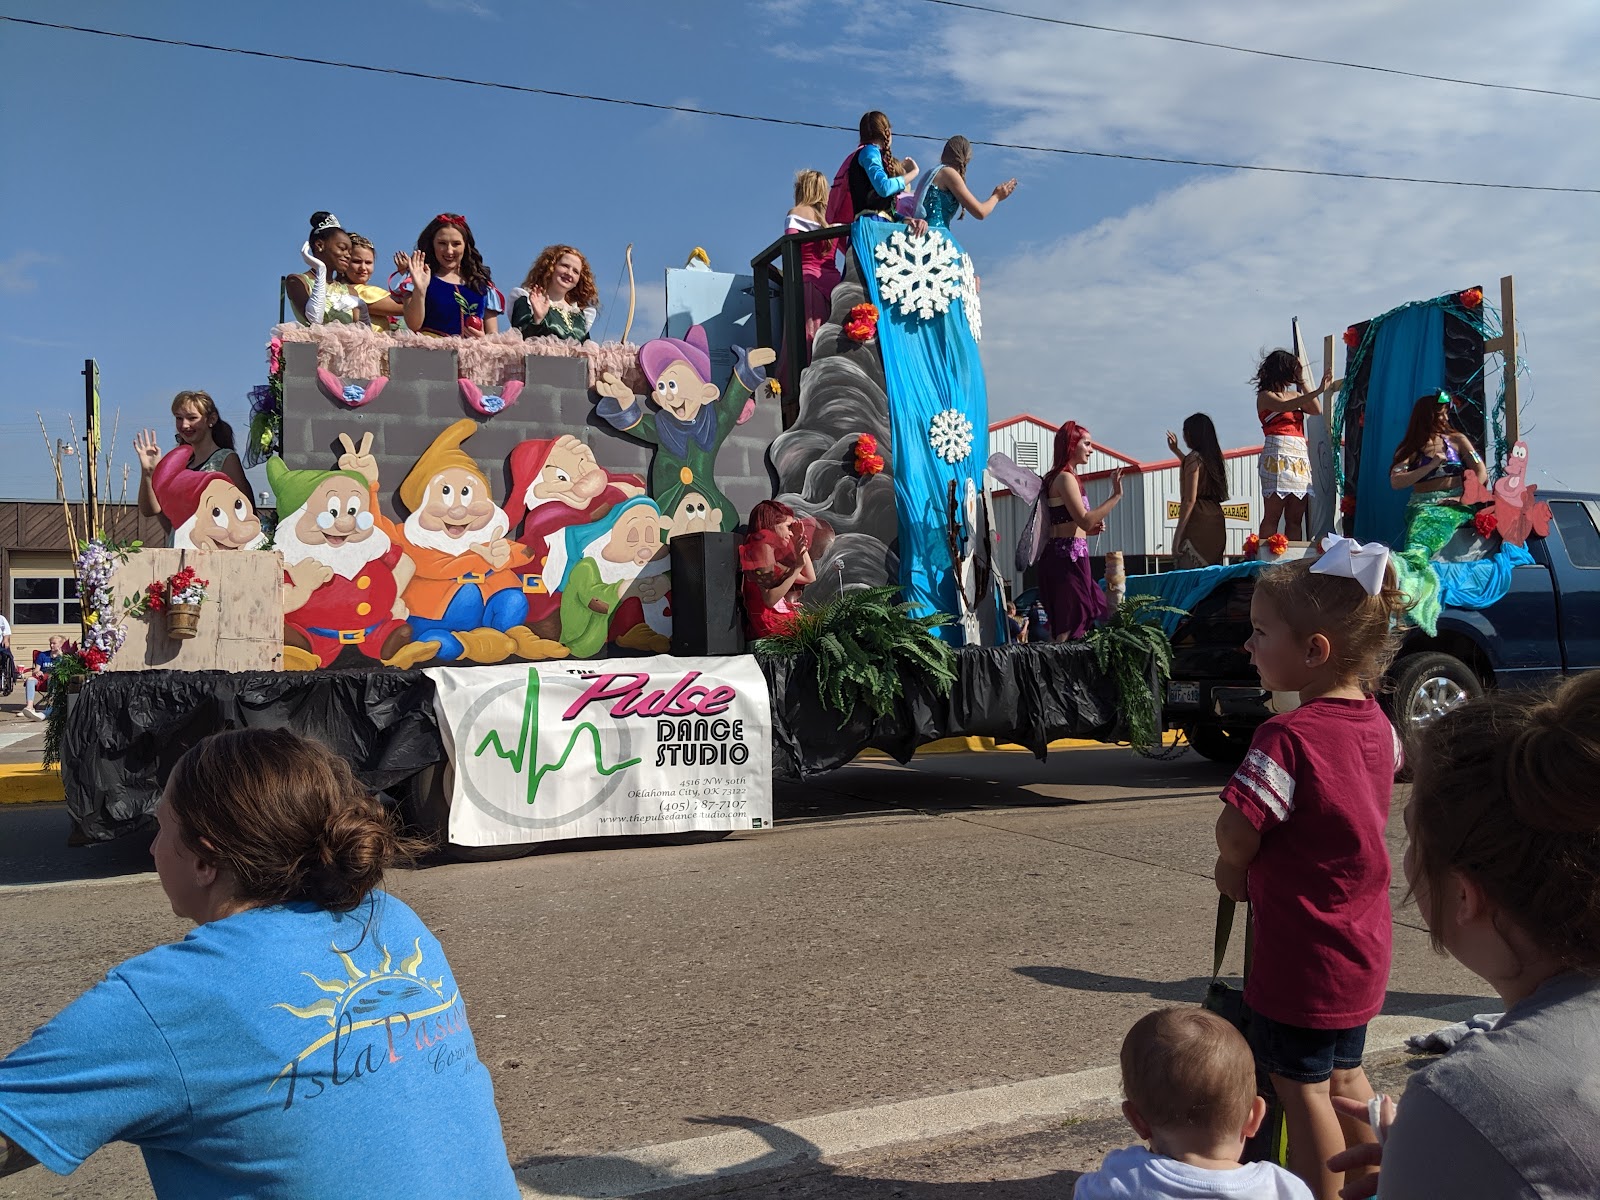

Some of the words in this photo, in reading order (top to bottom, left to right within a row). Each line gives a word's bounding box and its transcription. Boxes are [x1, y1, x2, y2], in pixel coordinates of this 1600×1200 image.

[1223, 506, 1247, 518] GARAGE
[562, 671, 736, 721] Pulse
[657, 718, 743, 742] DANCE
[655, 743, 749, 766] STUDIO
[702, 776, 723, 786] NW
[627, 788, 676, 799] Oklahoma
[678, 787, 701, 798] City,
[703, 787, 720, 796] OK
[659, 798, 690, 811] (405)
[599, 810, 747, 824] www.thepulsedancetudio.com
